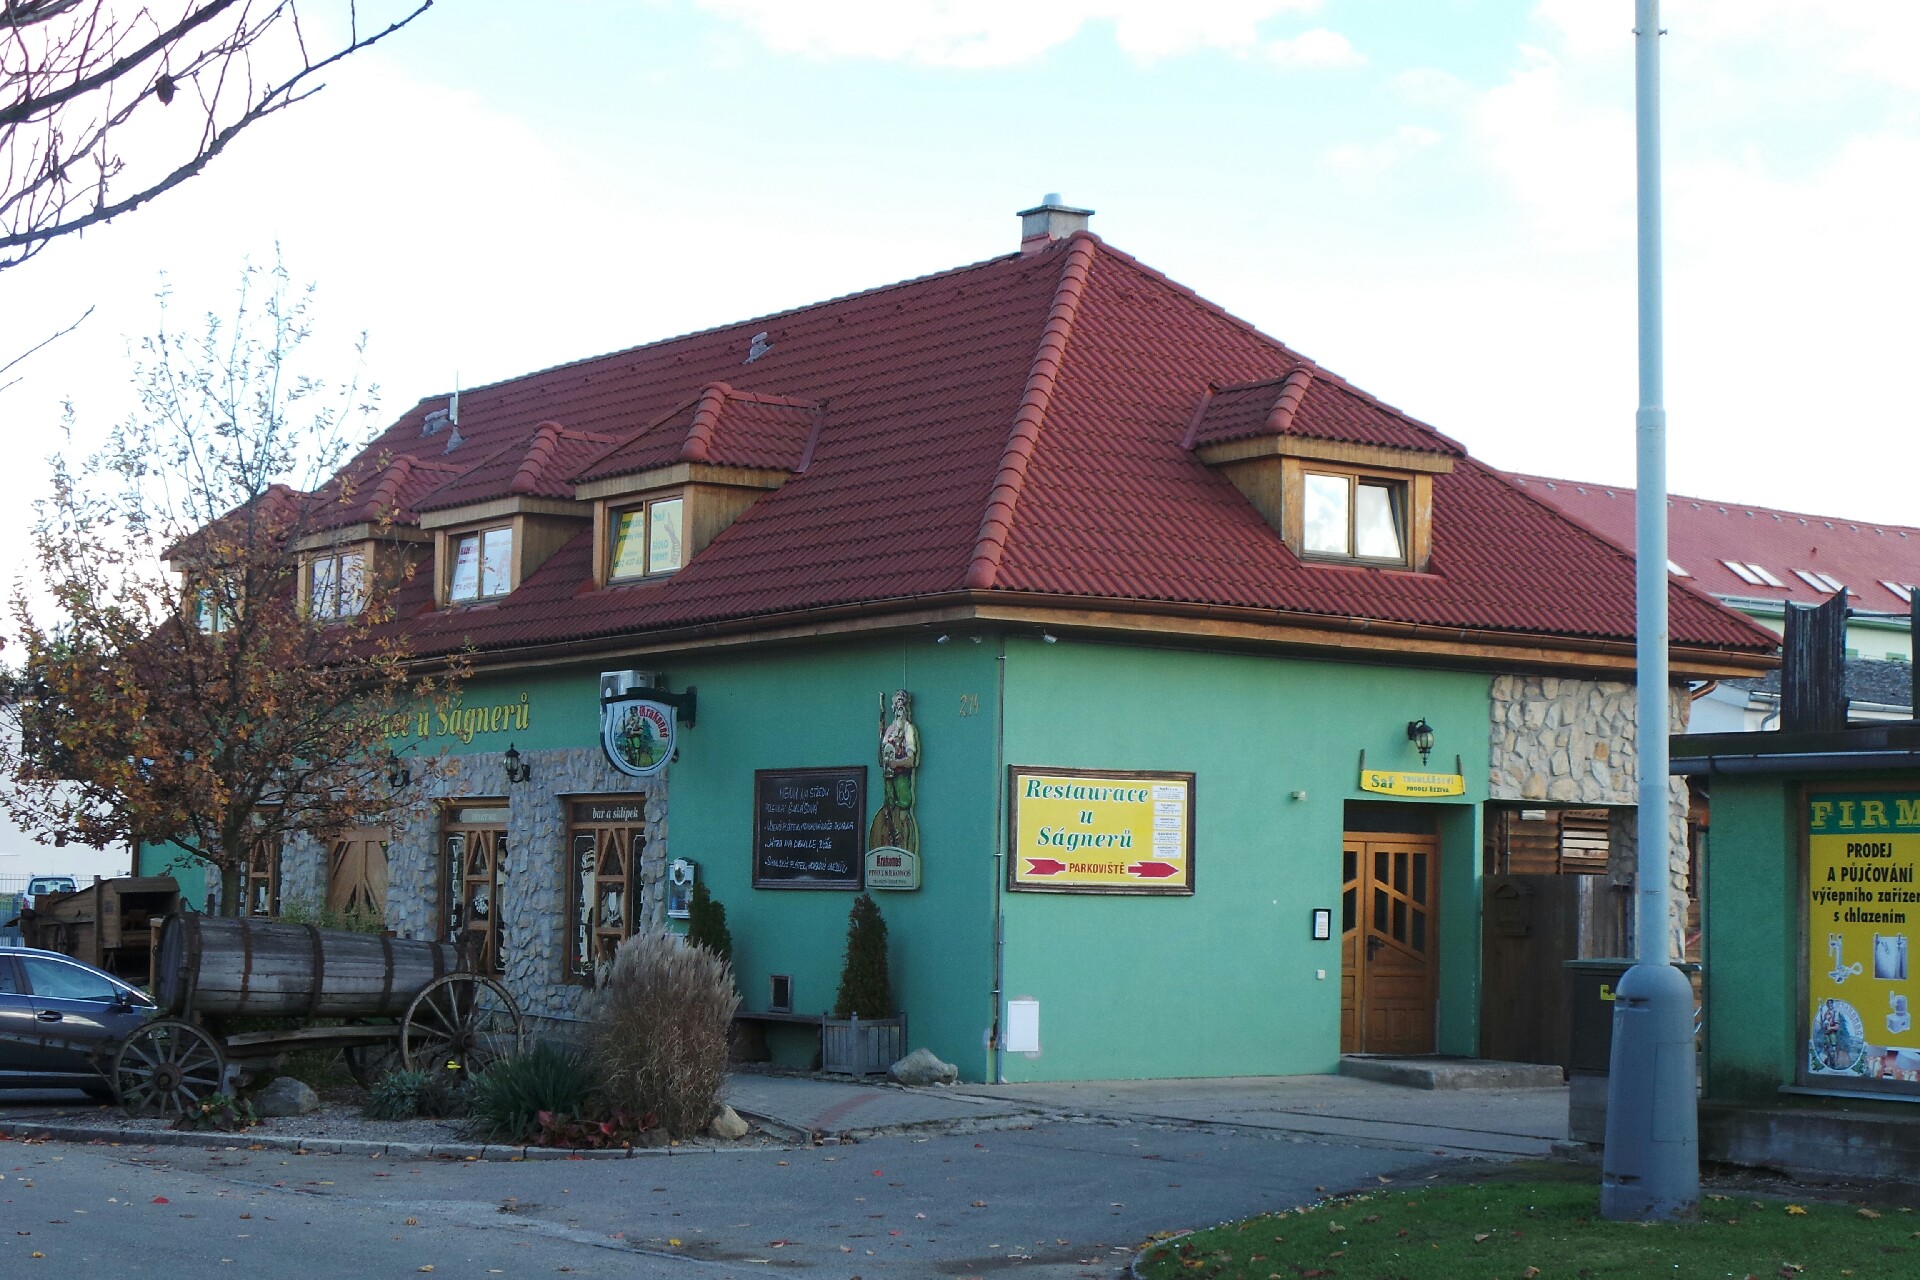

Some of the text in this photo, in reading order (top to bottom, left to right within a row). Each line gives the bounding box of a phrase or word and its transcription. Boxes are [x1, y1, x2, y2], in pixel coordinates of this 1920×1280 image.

[417, 711, 430, 737] u
[436, 692, 529, 744] Ságnerů
[639, 704, 670, 738] Krakonoš
[1025, 779, 1148, 803] Restaurace
[592, 808, 605, 819] bar
[613, 806, 638, 821] sklípek
[1079, 809, 1094, 824] u
[1037, 827, 1133, 851] Ságnerů
[1846, 842, 1892, 858] PRODEJ
[1069, 861, 1125, 875] PARKOVIŠTĚ
[1827, 862, 1914, 883] A PŮJČOVÁNÍ
[1812, 887, 1873, 905] výčepního
[1833, 907, 1906, 923] s chlazením
